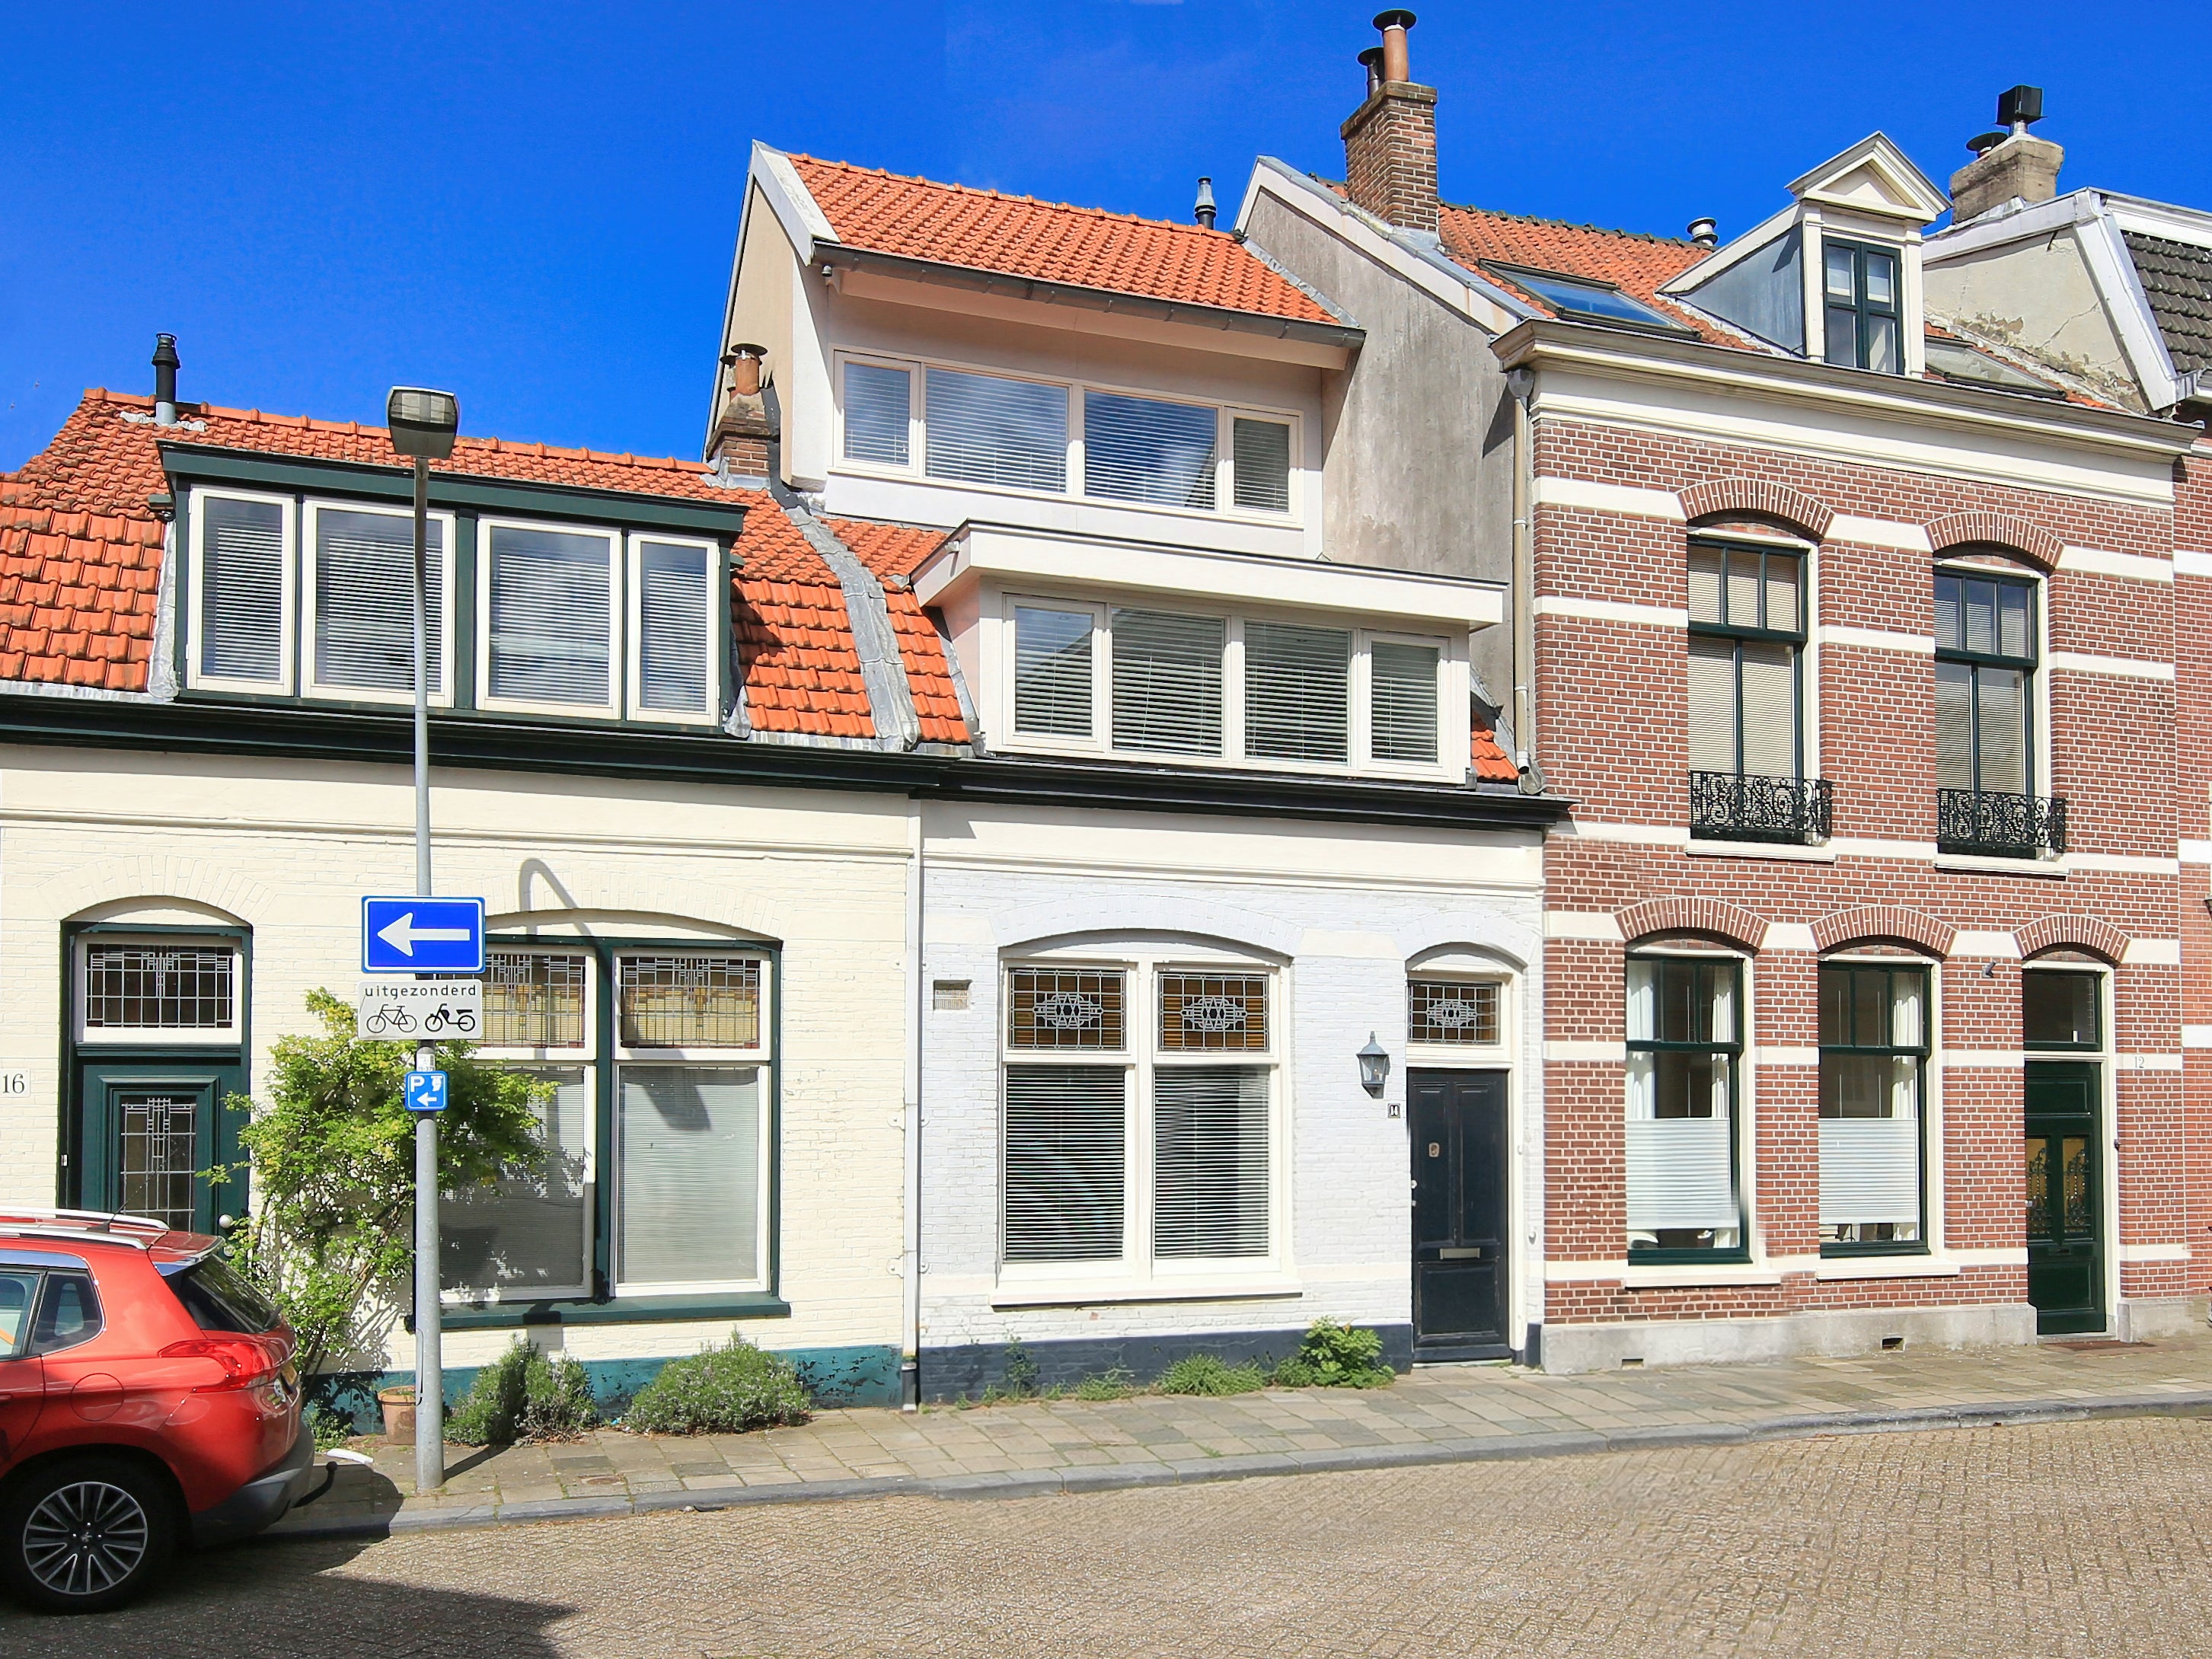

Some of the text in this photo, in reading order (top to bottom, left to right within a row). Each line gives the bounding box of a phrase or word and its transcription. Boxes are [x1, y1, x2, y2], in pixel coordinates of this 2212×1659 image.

[365, 984, 476, 1000] uitgezonderd
[2134, 1056, 2144, 1068] 12
[2, 1073, 25, 1094] 16
[410, 1075, 425, 1093] P
